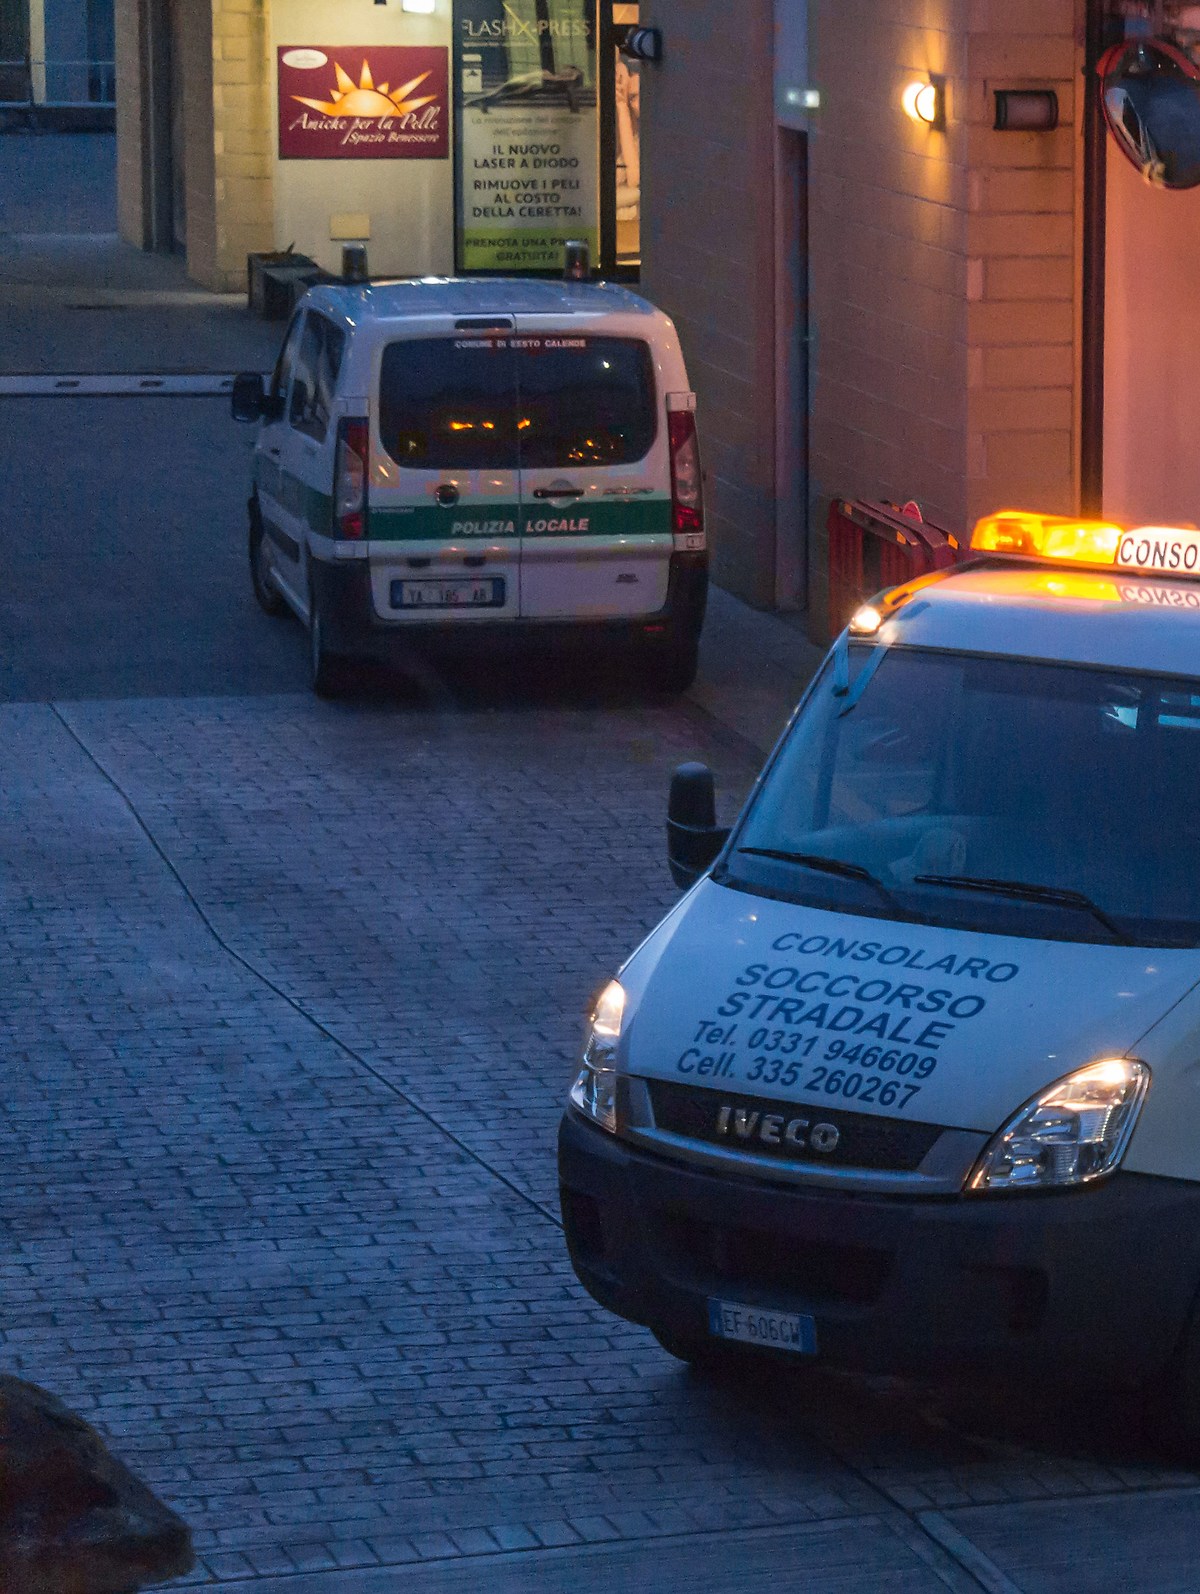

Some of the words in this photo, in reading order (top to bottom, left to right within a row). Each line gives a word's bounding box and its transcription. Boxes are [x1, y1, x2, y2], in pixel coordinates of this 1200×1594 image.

[289, 112, 349, 131] Amiche
[377, 107, 394, 130] la
[400, 105, 441, 131] Pelle
[349, 131, 386, 144] Spazio
[493, 145, 504, 155] IL
[509, 144, 561, 155] NUOVO
[474, 159, 516, 169] LASER
[520, 159, 529, 169] A
[533, 158, 580, 169] DIODO
[473, 180, 539, 190] RIMUOVE
[552, 179, 580, 190] PELI
[494, 193, 512, 204] AL
[515, 193, 561, 204] COSTO
[473, 207, 515, 218] DELLA
[519, 206, 582, 218] CERETTA!
[466, 239, 519, 248] PRENOTA
[522, 239, 548, 248] UNA
[455, 340, 493, 349] COMUNE
[544, 339, 587, 348] CALENDE
[451, 520, 515, 534] POLIZIA
[526, 518, 590, 532] LOCALE
[772, 932, 1020, 984] CONSOLARO
[735, 963, 987, 1019] SOCCORSO
[717, 991, 956, 1050] STRADALE
[693, 1020, 736, 1047] Tel.
[747, 1027, 817, 1058] 0331
[823, 1039, 938, 1080] 946609
[677, 1047, 735, 1079] Cell.
[746, 1056, 800, 1086] 335
[804, 1065, 923, 1110] 260267
[715, 1105, 840, 1154] IVECO
